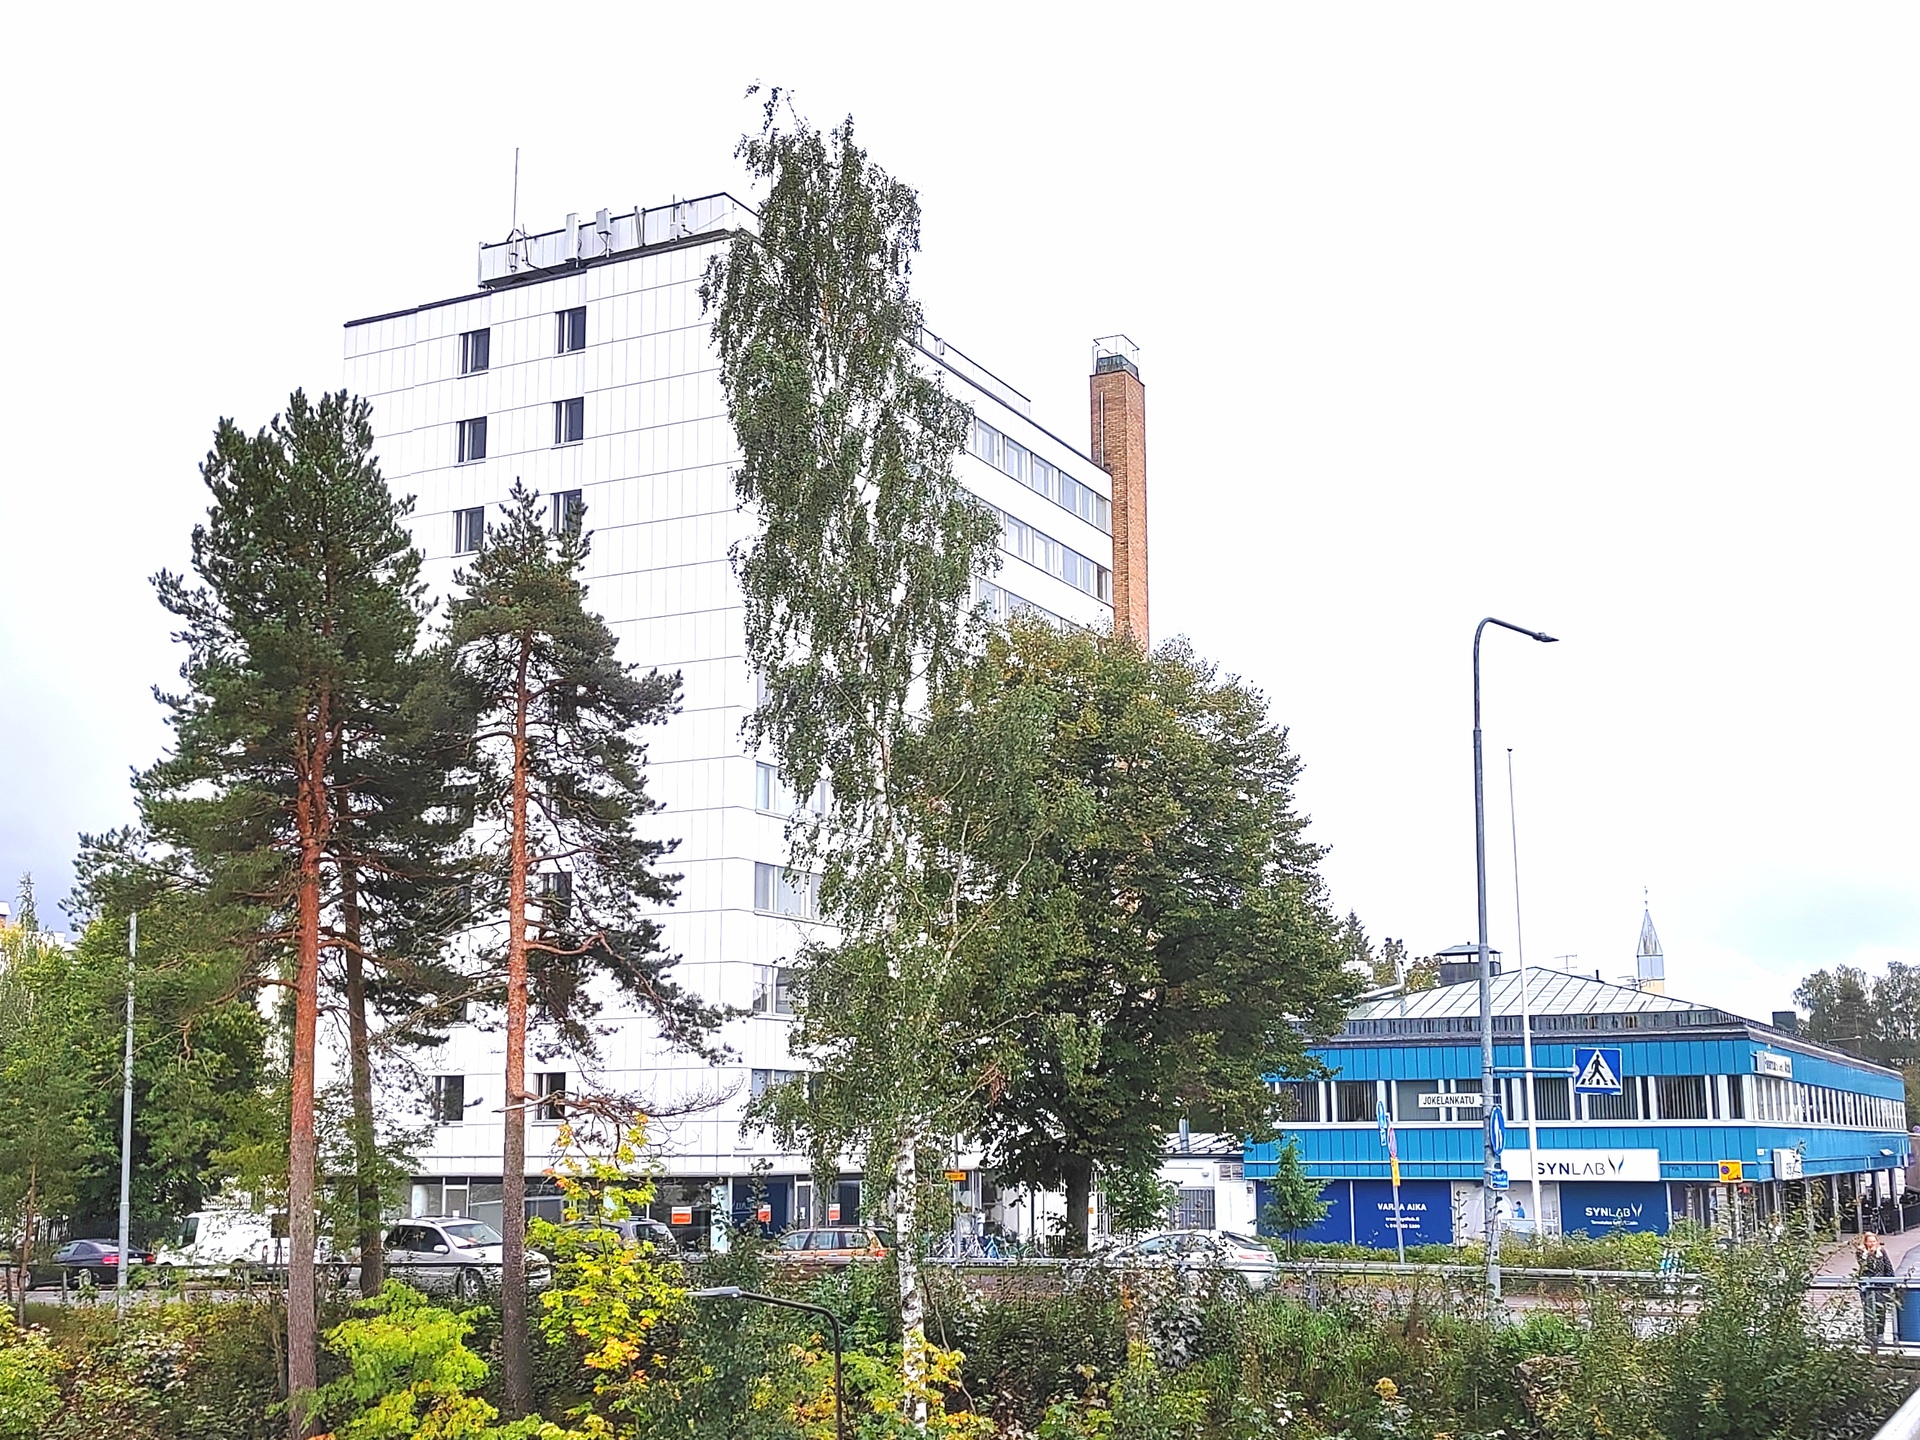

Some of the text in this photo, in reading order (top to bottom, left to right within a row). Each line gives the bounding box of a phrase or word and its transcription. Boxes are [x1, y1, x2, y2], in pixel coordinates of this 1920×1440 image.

[1423, 1096, 1475, 1105] JOKELANKATU
[1538, 1162, 1606, 1175] SYNLAB
[1377, 1203, 1427, 1211] VARA AIKA
[1585, 1207, 1631, 1217] SYNLAB
